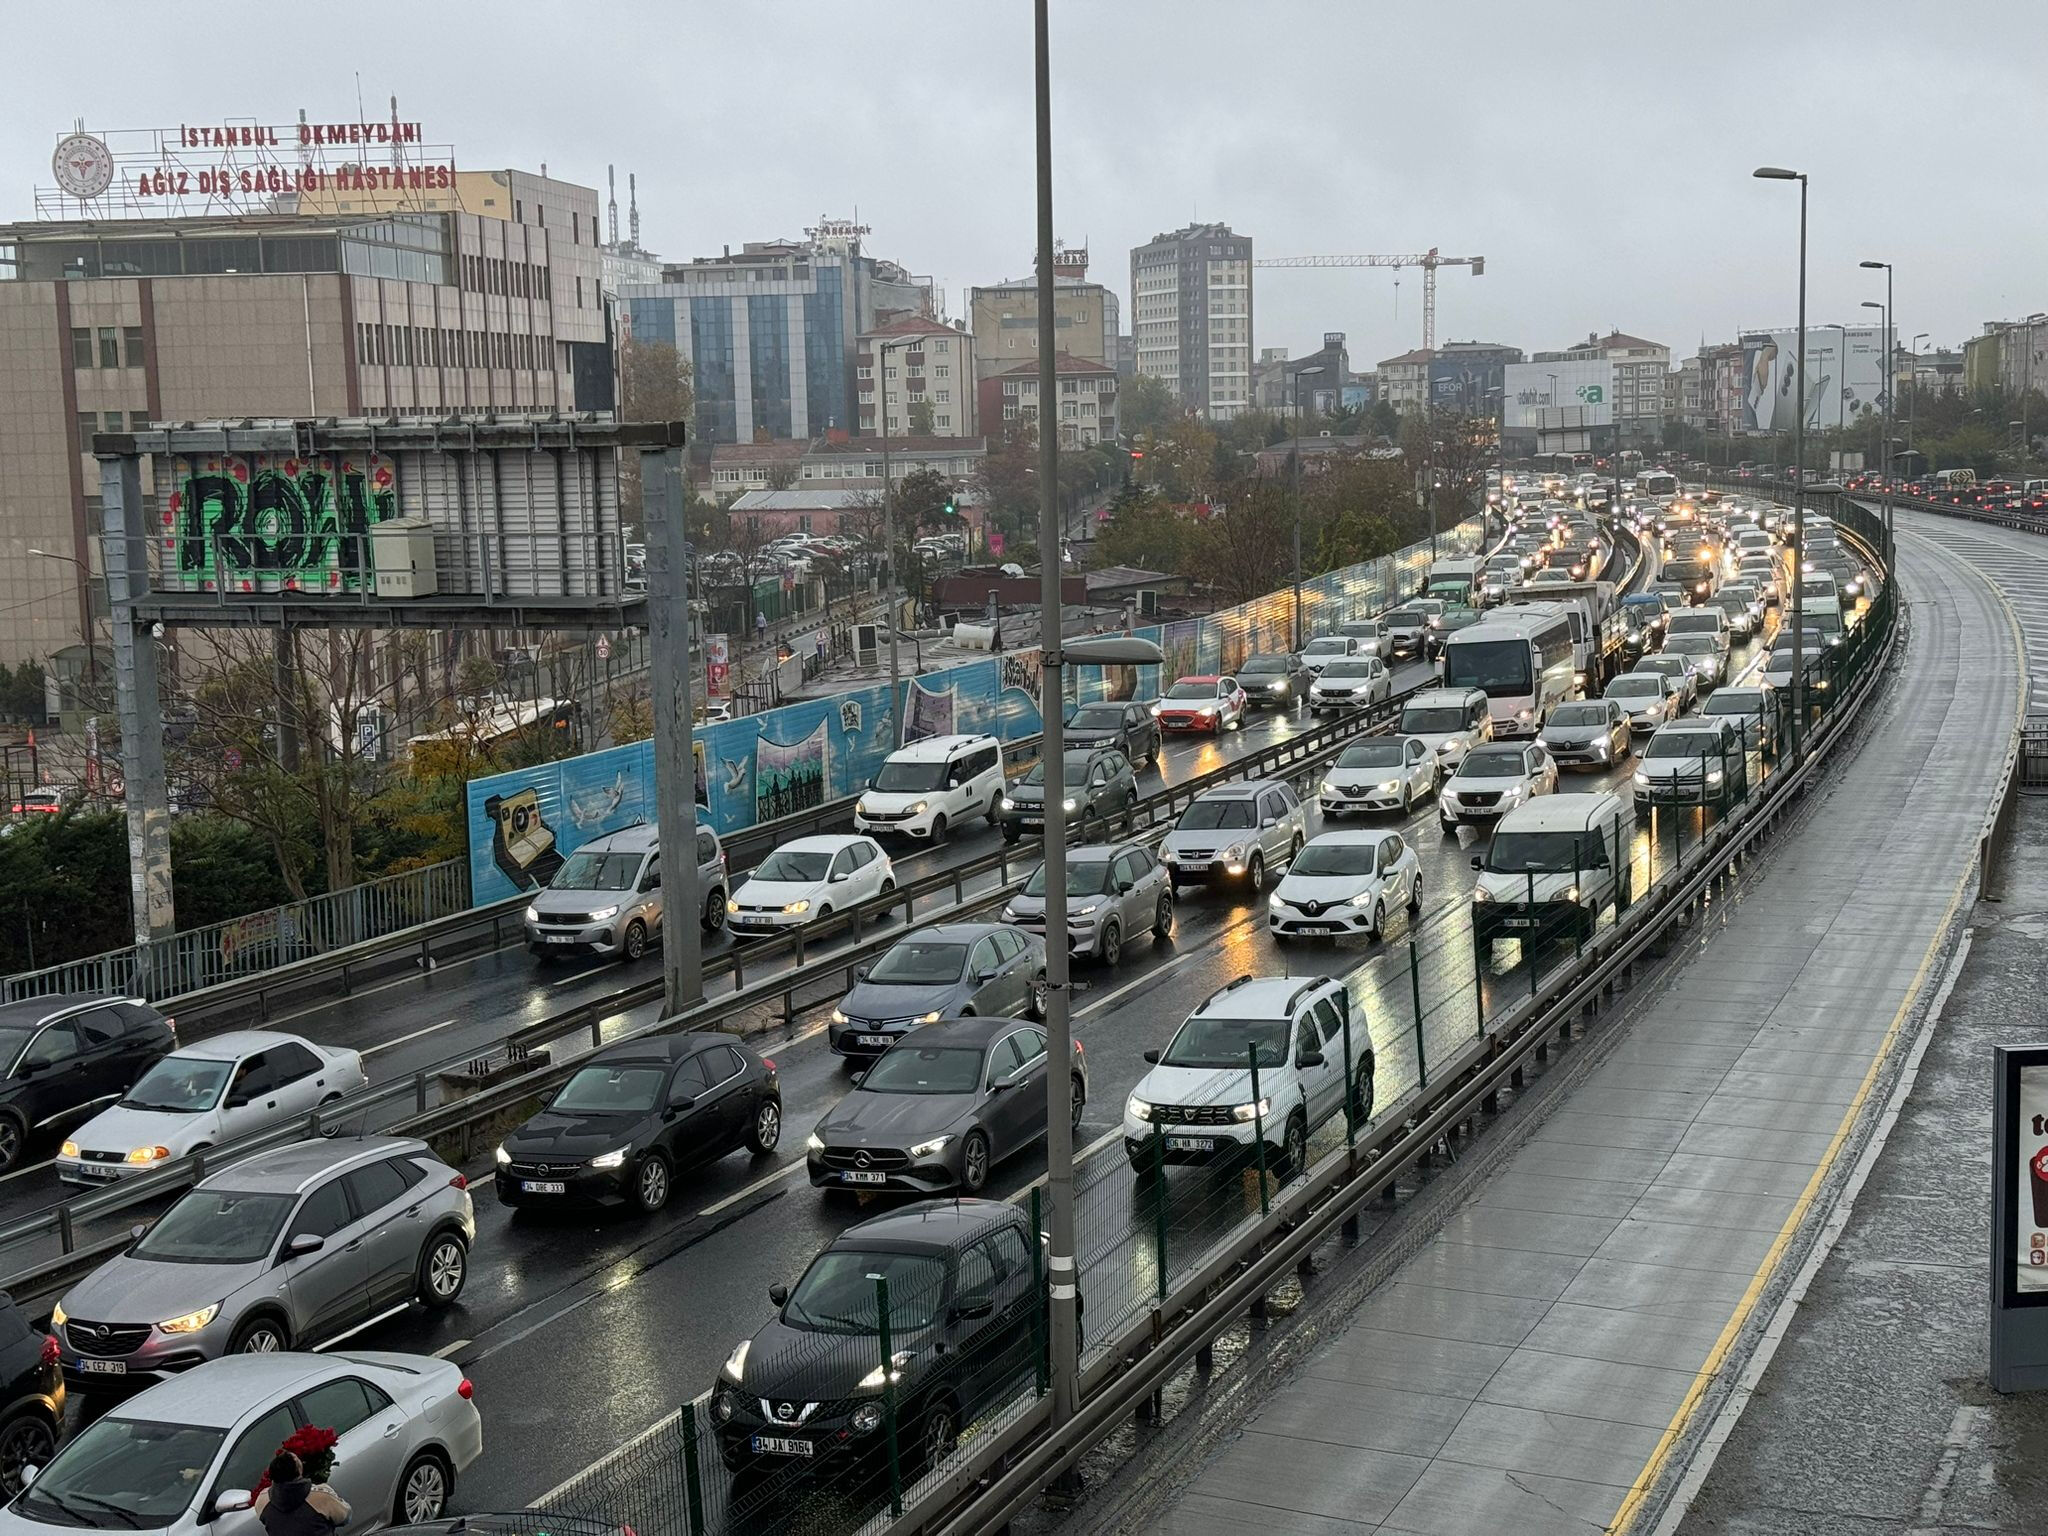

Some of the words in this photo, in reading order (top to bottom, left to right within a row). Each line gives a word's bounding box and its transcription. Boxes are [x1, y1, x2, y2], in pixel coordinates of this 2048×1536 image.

[181, 123, 278, 148] İSTANBUL
[139, 166, 190, 196] AĞIZ
[199, 165, 231, 199] DİŞ
[241, 164, 326, 193] SAĞLIĞI
[336, 159, 457, 191] HASTANESİ
[1438, 382, 1463, 393] EFOR
[364, 726, 372, 736] P
[845, 1171, 853, 1180] 34
[870, 1173, 884, 1182] 371
[525, 1182, 533, 1190] 34
[550, 1183, 564, 1192] 333
[80, 1360, 90, 1371] 34
[92, 1361, 107, 1372] CEZ
[110, 1362, 124, 1373] 319
[756, 1437, 768, 1450] 34
